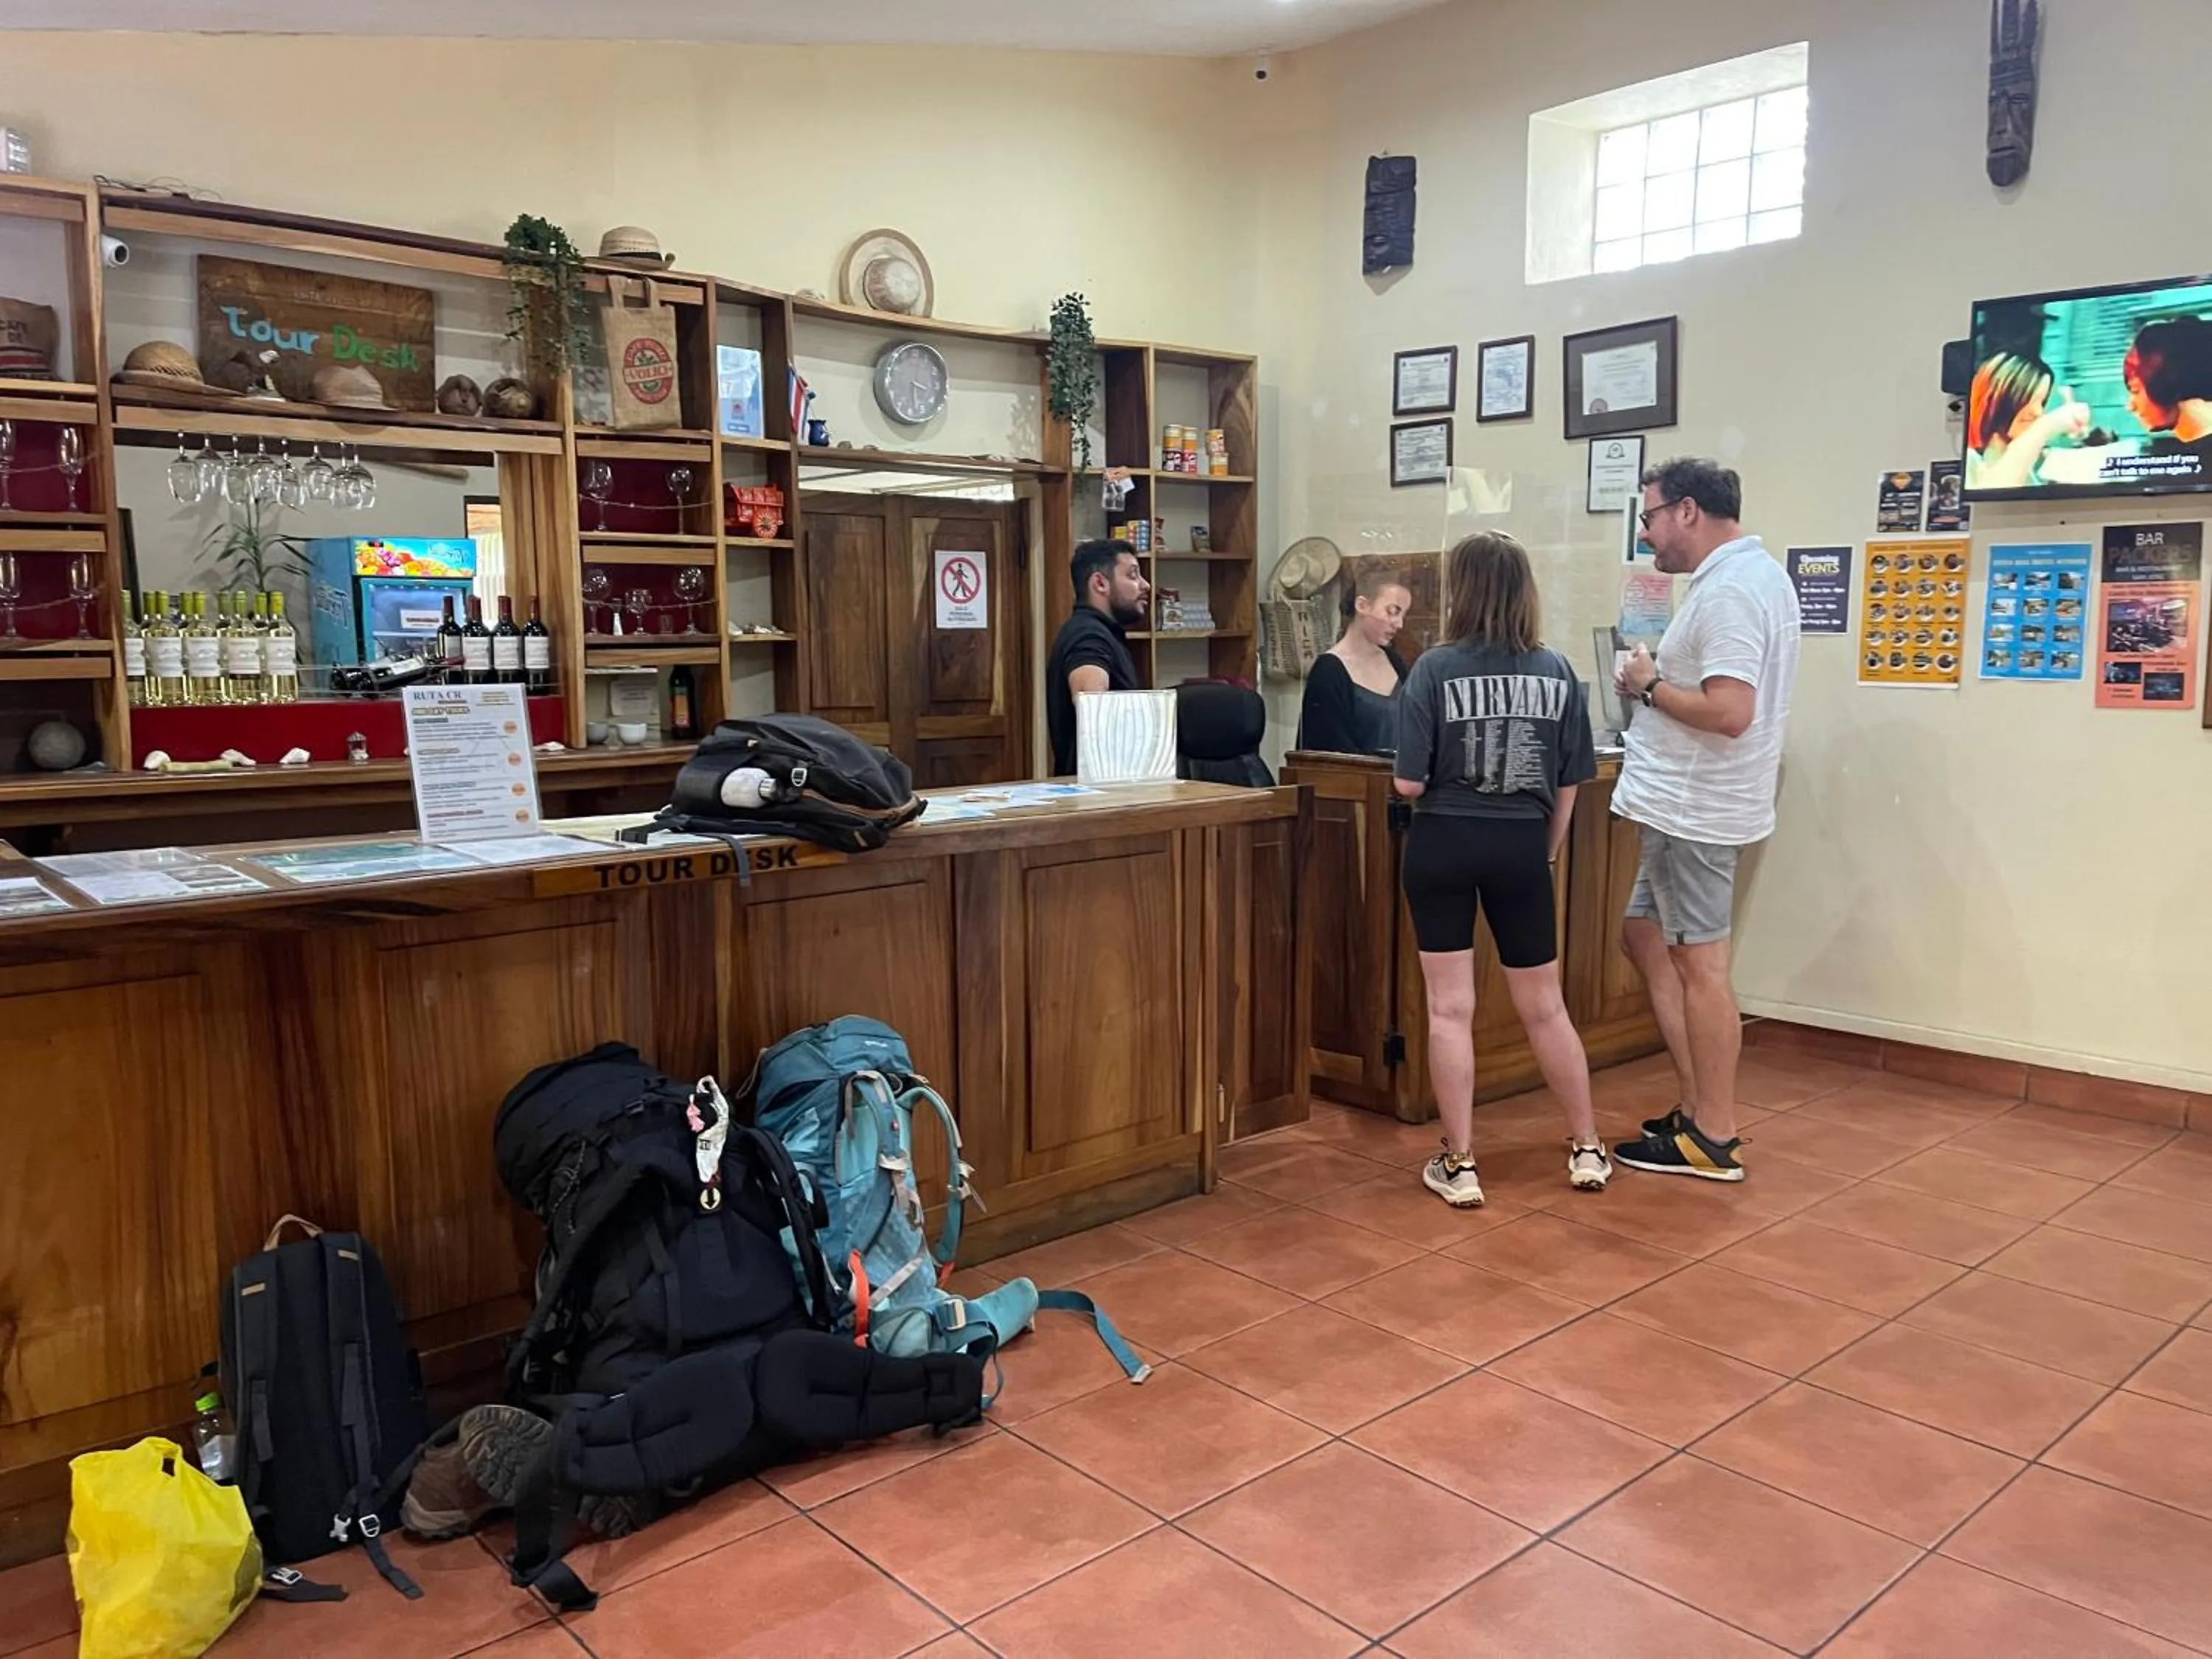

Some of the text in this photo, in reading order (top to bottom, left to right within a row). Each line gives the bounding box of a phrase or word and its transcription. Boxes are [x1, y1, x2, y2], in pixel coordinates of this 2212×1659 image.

[221, 306, 419, 372] Tour Desk
[2135, 532, 2165, 546] BAR
[1798, 563, 1840, 574] EVENTS
[594, 857, 694, 888] TOUR
